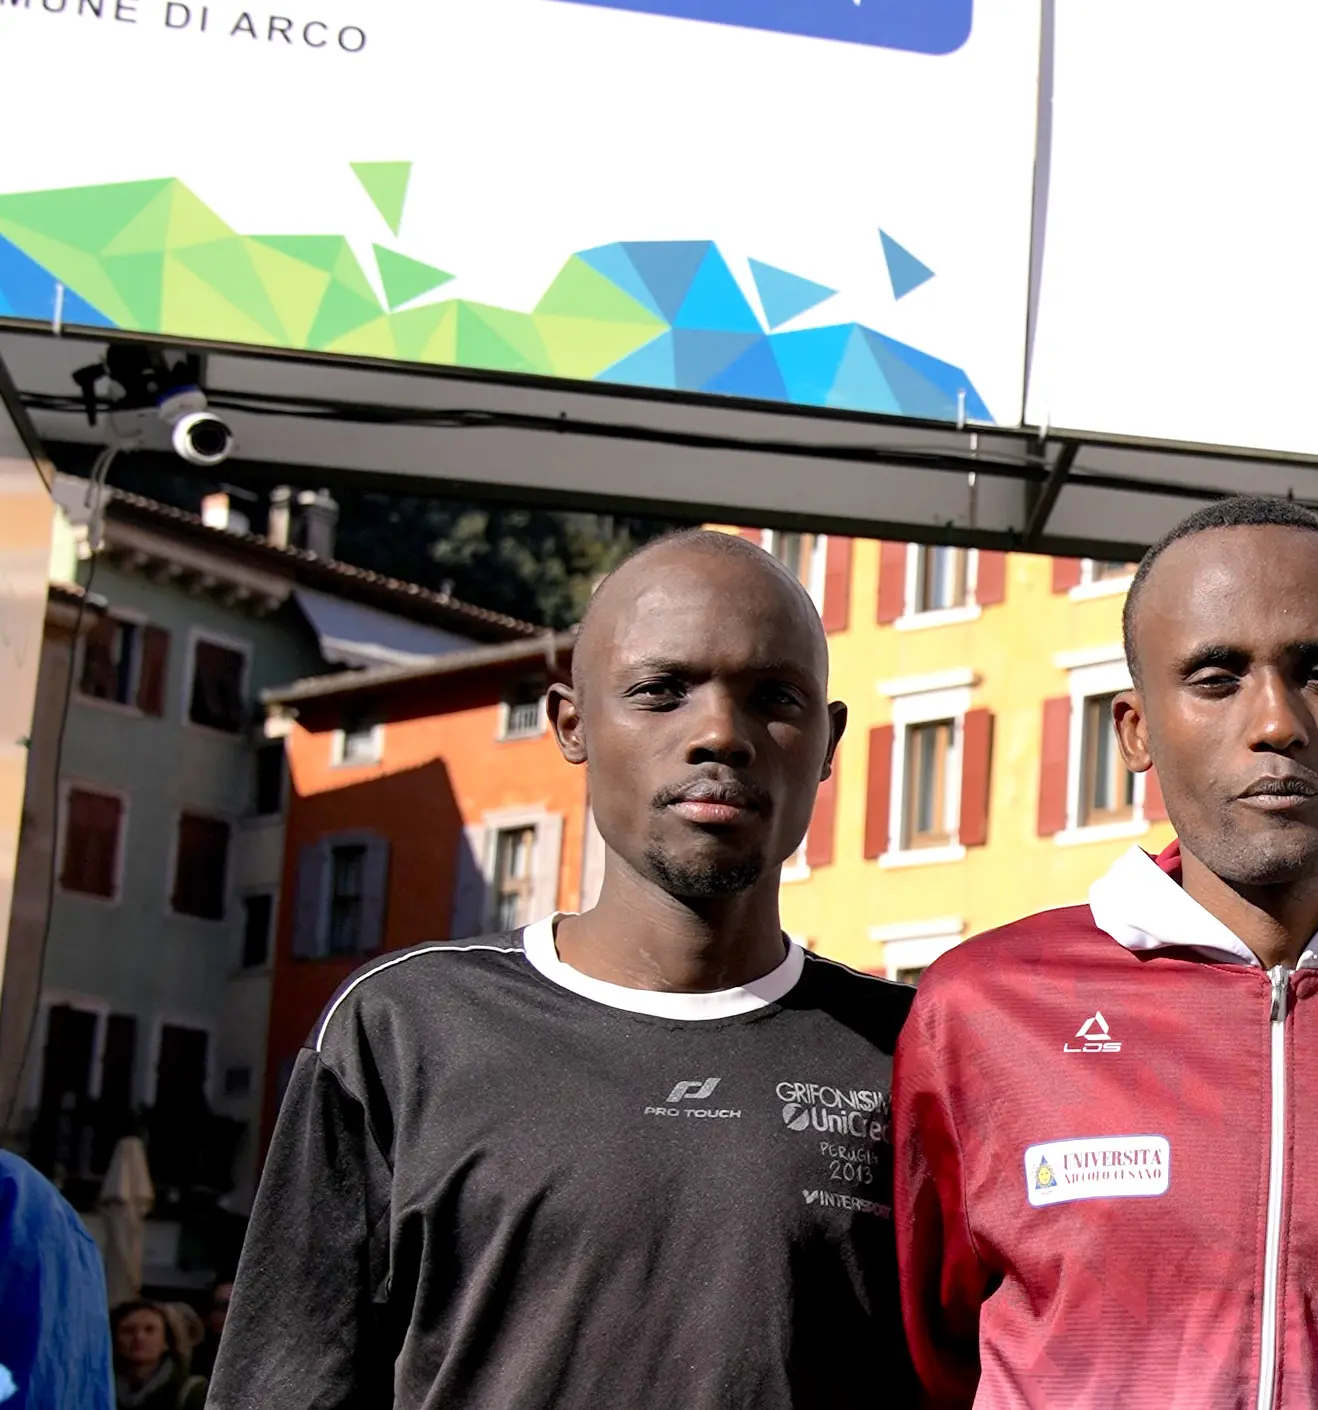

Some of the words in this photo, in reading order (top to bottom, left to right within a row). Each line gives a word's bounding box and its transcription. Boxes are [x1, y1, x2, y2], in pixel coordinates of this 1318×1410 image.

[164, 1, 209, 32] DI
[230, 11, 367, 53] ARCO
[1063, 1042, 1122, 1053] LDS
[644, 1107, 680, 1117] PRO
[684, 1109, 742, 1118] TOUCH
[829, 1160, 873, 1184] 2013
